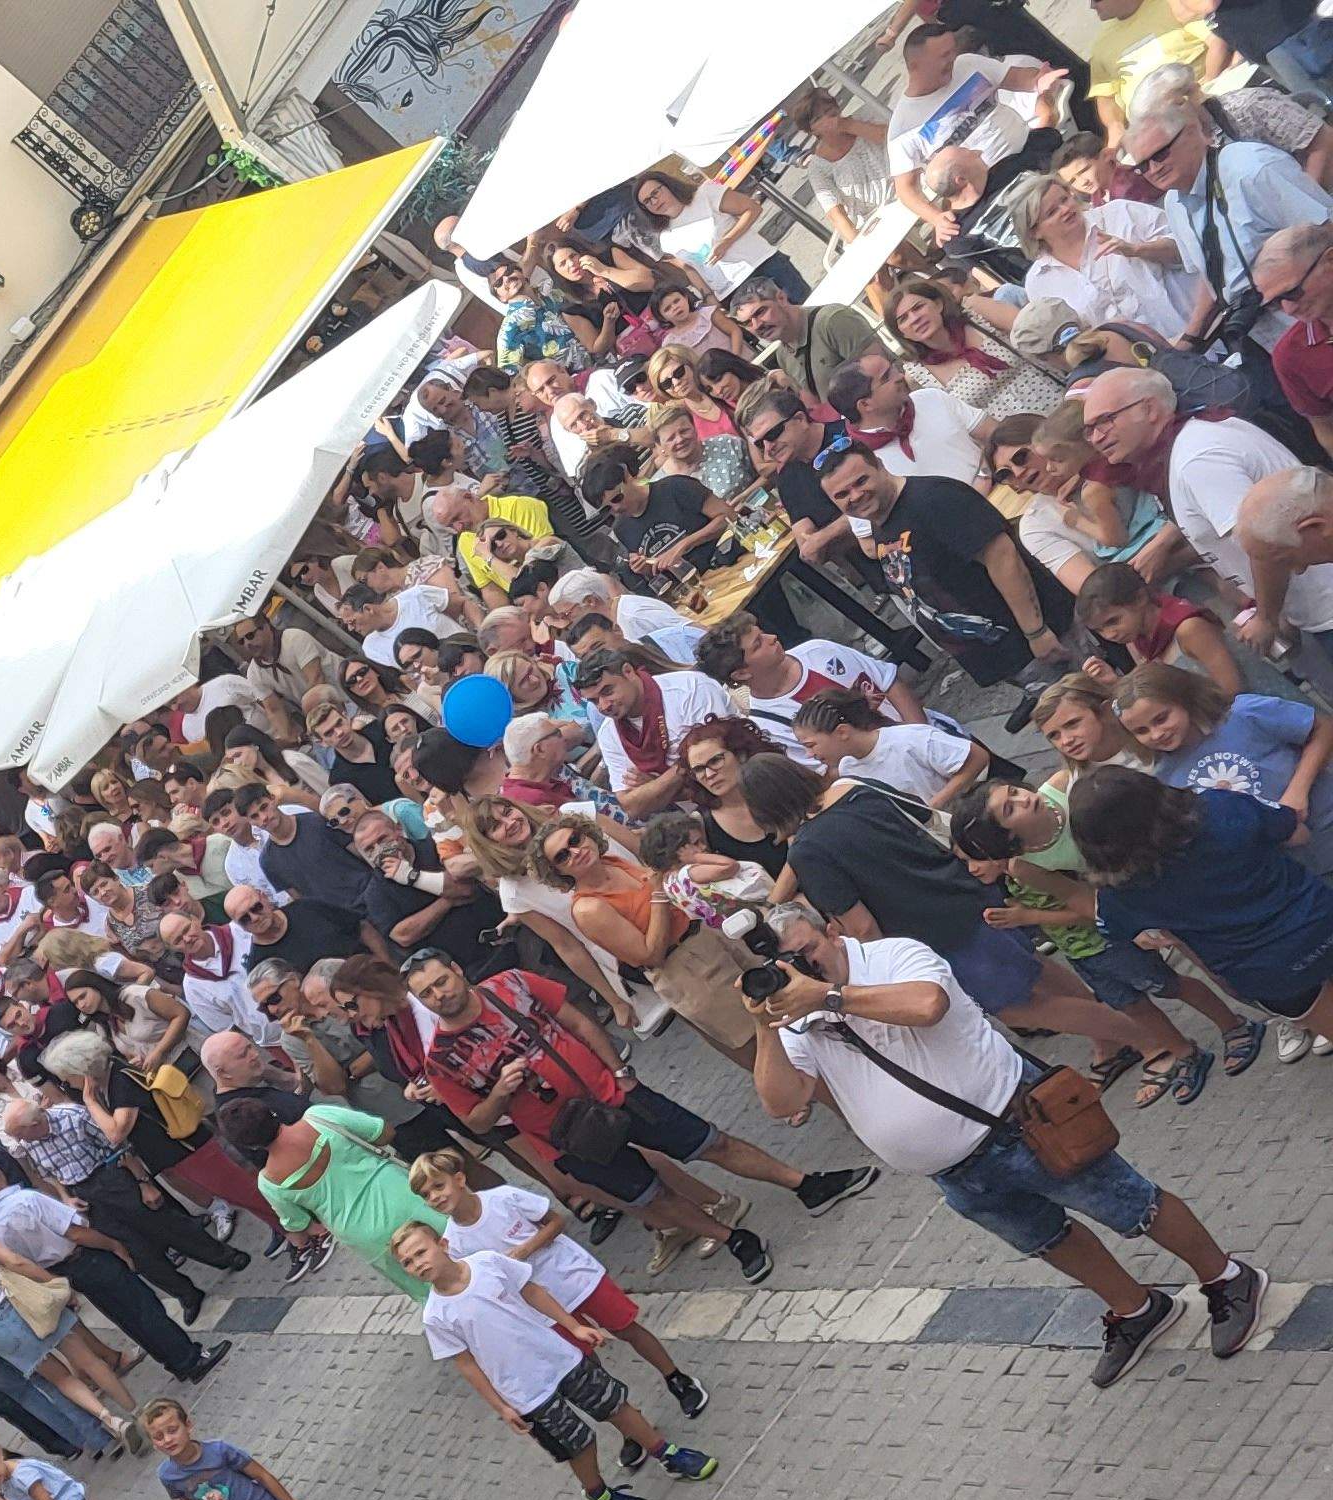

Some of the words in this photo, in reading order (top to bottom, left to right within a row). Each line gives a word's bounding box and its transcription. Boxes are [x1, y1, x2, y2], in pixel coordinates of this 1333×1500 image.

[10, 720, 45, 763] AMBAR
[1197, 756, 1212, 768] OR
[1238, 756, 1260, 780] WHO
